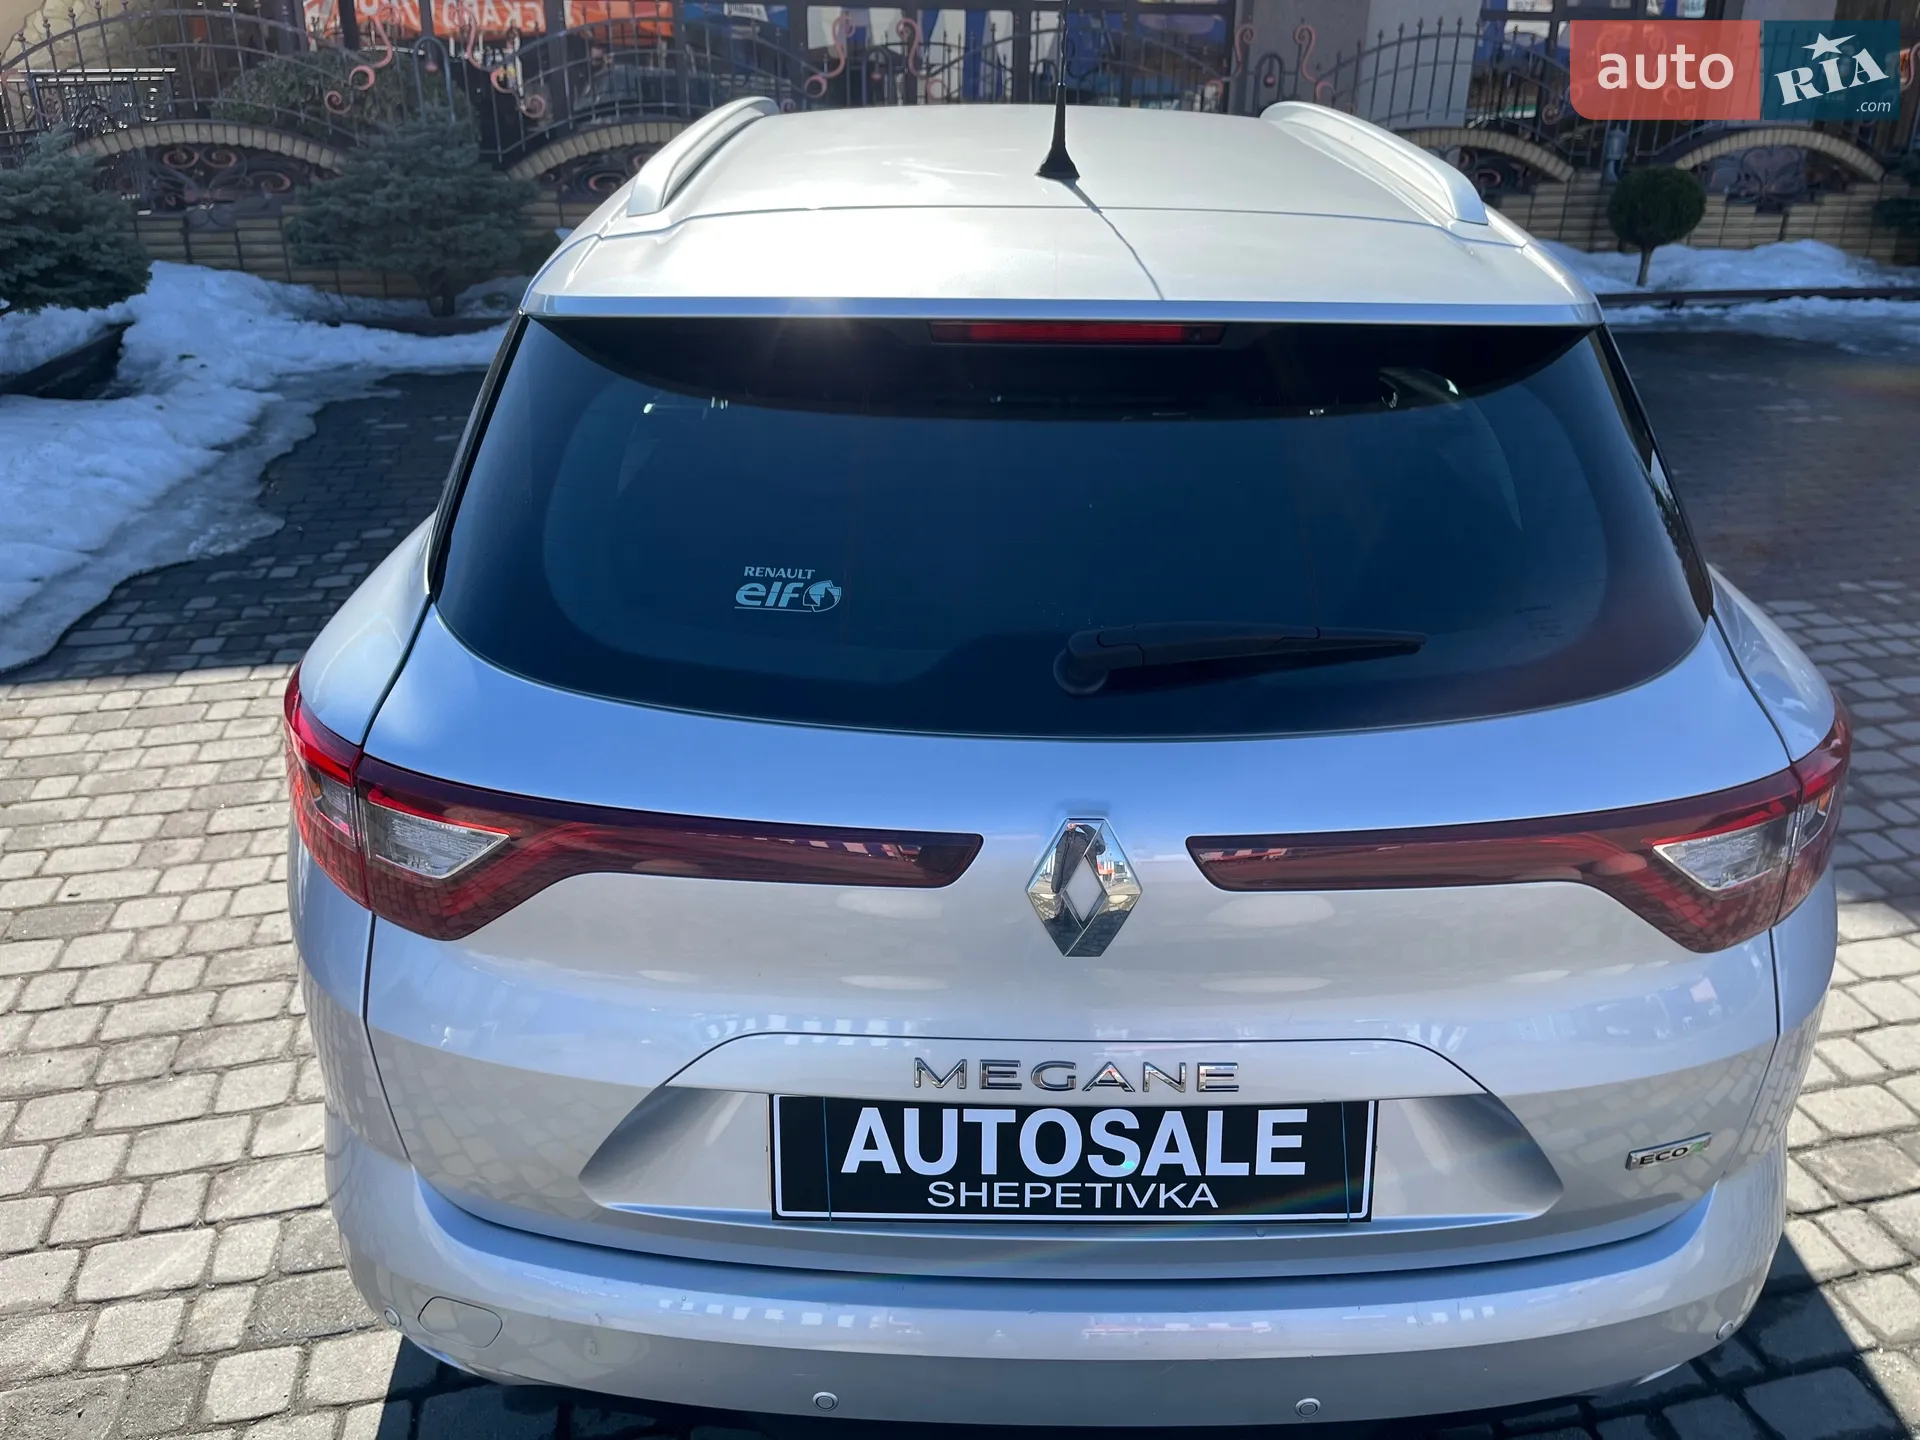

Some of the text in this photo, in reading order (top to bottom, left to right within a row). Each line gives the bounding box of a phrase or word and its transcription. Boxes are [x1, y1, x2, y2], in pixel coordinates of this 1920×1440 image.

[743, 566, 815, 580] RENAULT
[735, 581, 804, 607] elf
[914, 1057, 1240, 1093] MEGANE
[841, 1106, 1308, 1178] AUTOSALE
[928, 1181, 1219, 1208] SHEPETIVKA
